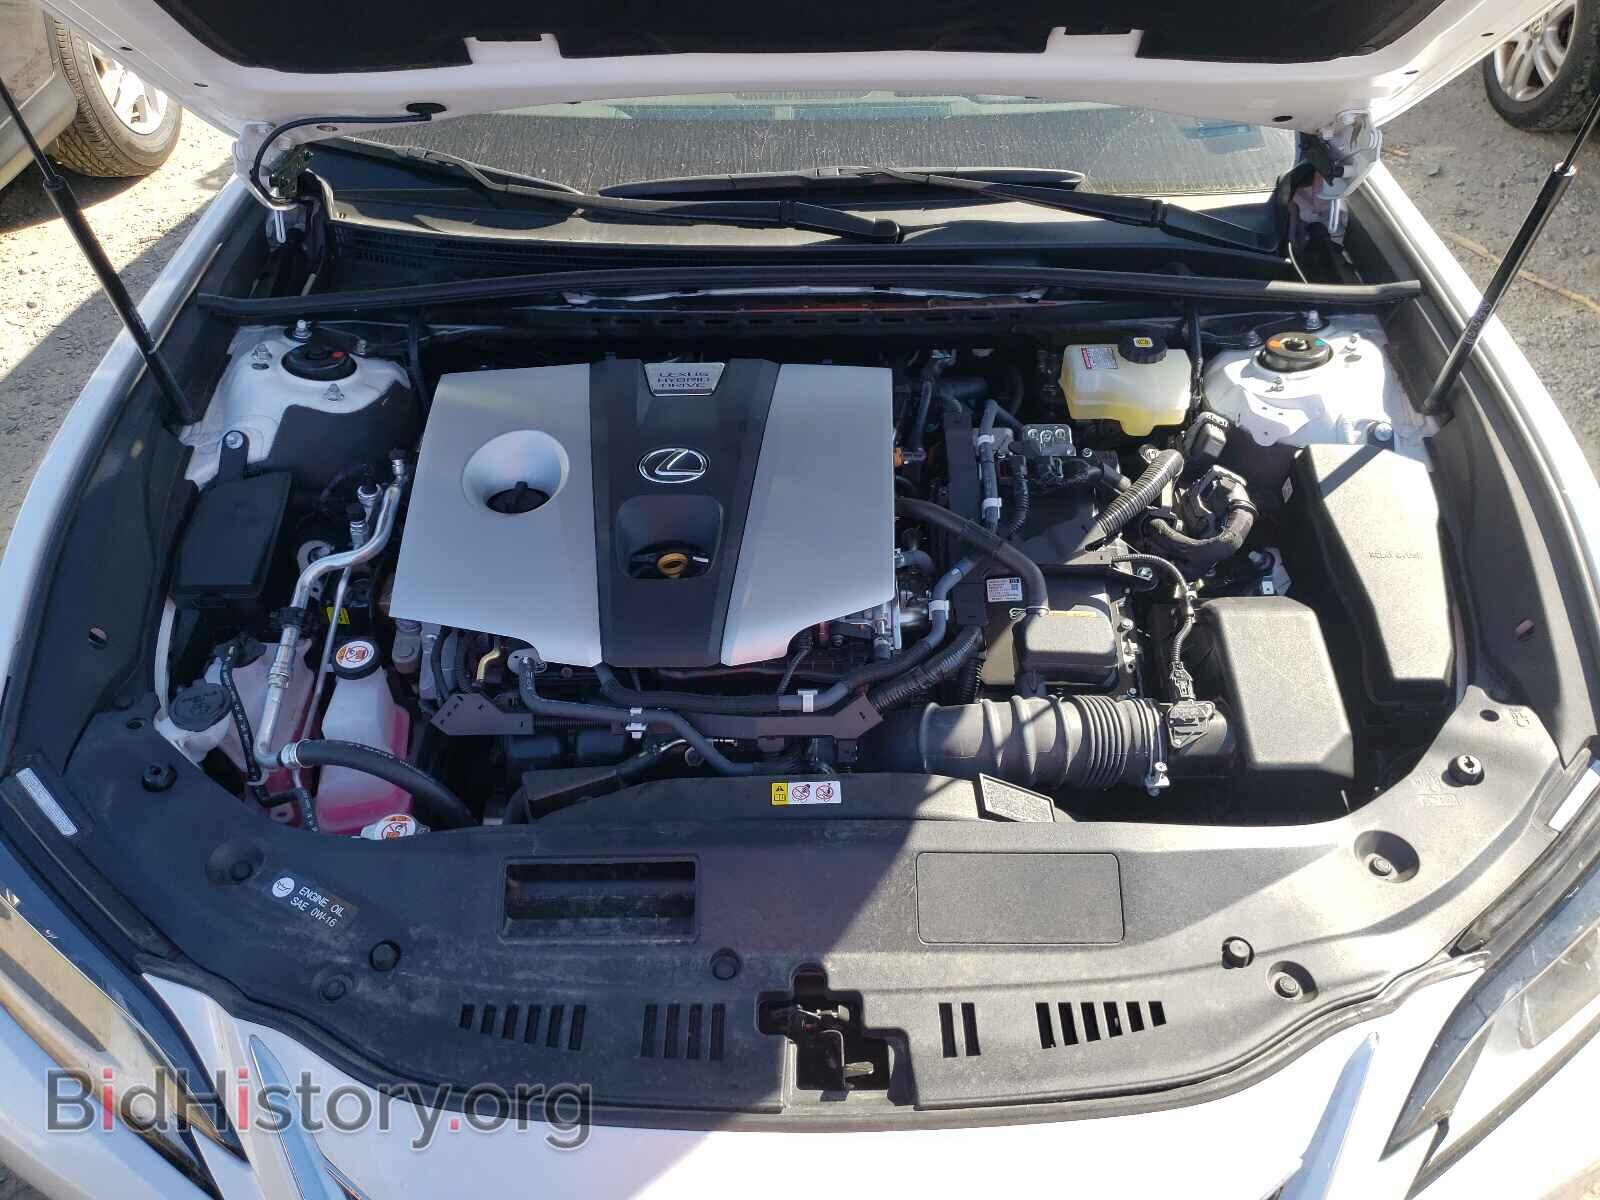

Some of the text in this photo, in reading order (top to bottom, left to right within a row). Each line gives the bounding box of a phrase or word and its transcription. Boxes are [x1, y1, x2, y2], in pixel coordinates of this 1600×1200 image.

[290, 896, 338, 927] SAE 0W-16
[298, 886, 345, 918] ENGINE OIL
